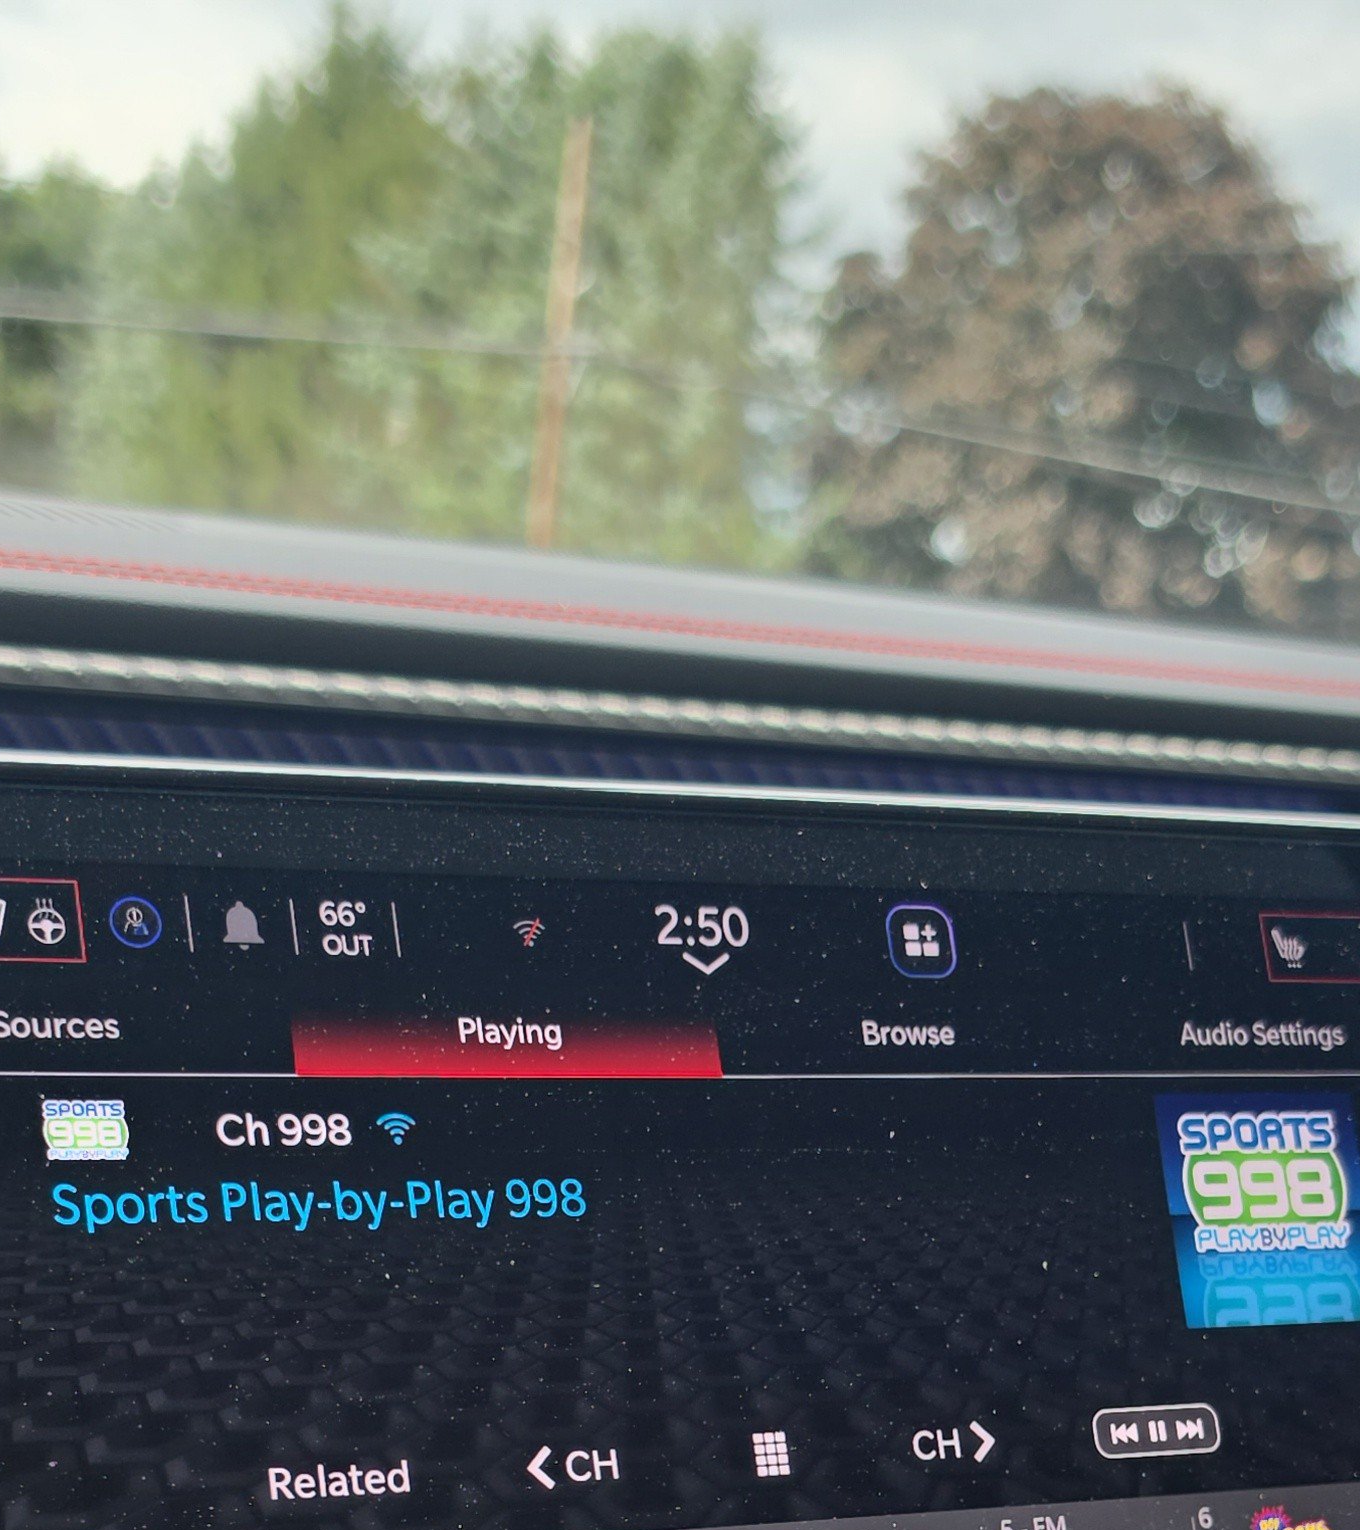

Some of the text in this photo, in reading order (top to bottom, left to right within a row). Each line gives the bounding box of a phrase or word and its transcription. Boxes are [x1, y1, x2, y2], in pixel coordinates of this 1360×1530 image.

[319, 901, 365, 926] 66°
[655, 905, 749, 946] 2:50
[323, 934, 372, 956] OUT
[458, 1017, 562, 1050] Playing
[862, 1020, 955, 1046] Browse
[1181, 1022, 1345, 1051] Audio Settings
[44, 1102, 123, 1117] SPORTS
[47, 1119, 123, 1149] 998
[217, 1113, 352, 1146] Ch 998
[1180, 1116, 1334, 1152] SPORTS
[1192, 1158, 1337, 1221] 998
[53, 1179, 586, 1233] Sports Play-by-Play 998
[913, 1428, 961, 1460] CH
[269, 1460, 410, 1500] Related
[566, 1449, 619, 1481] CH
[1198, 1507, 1212, 1528] 6
